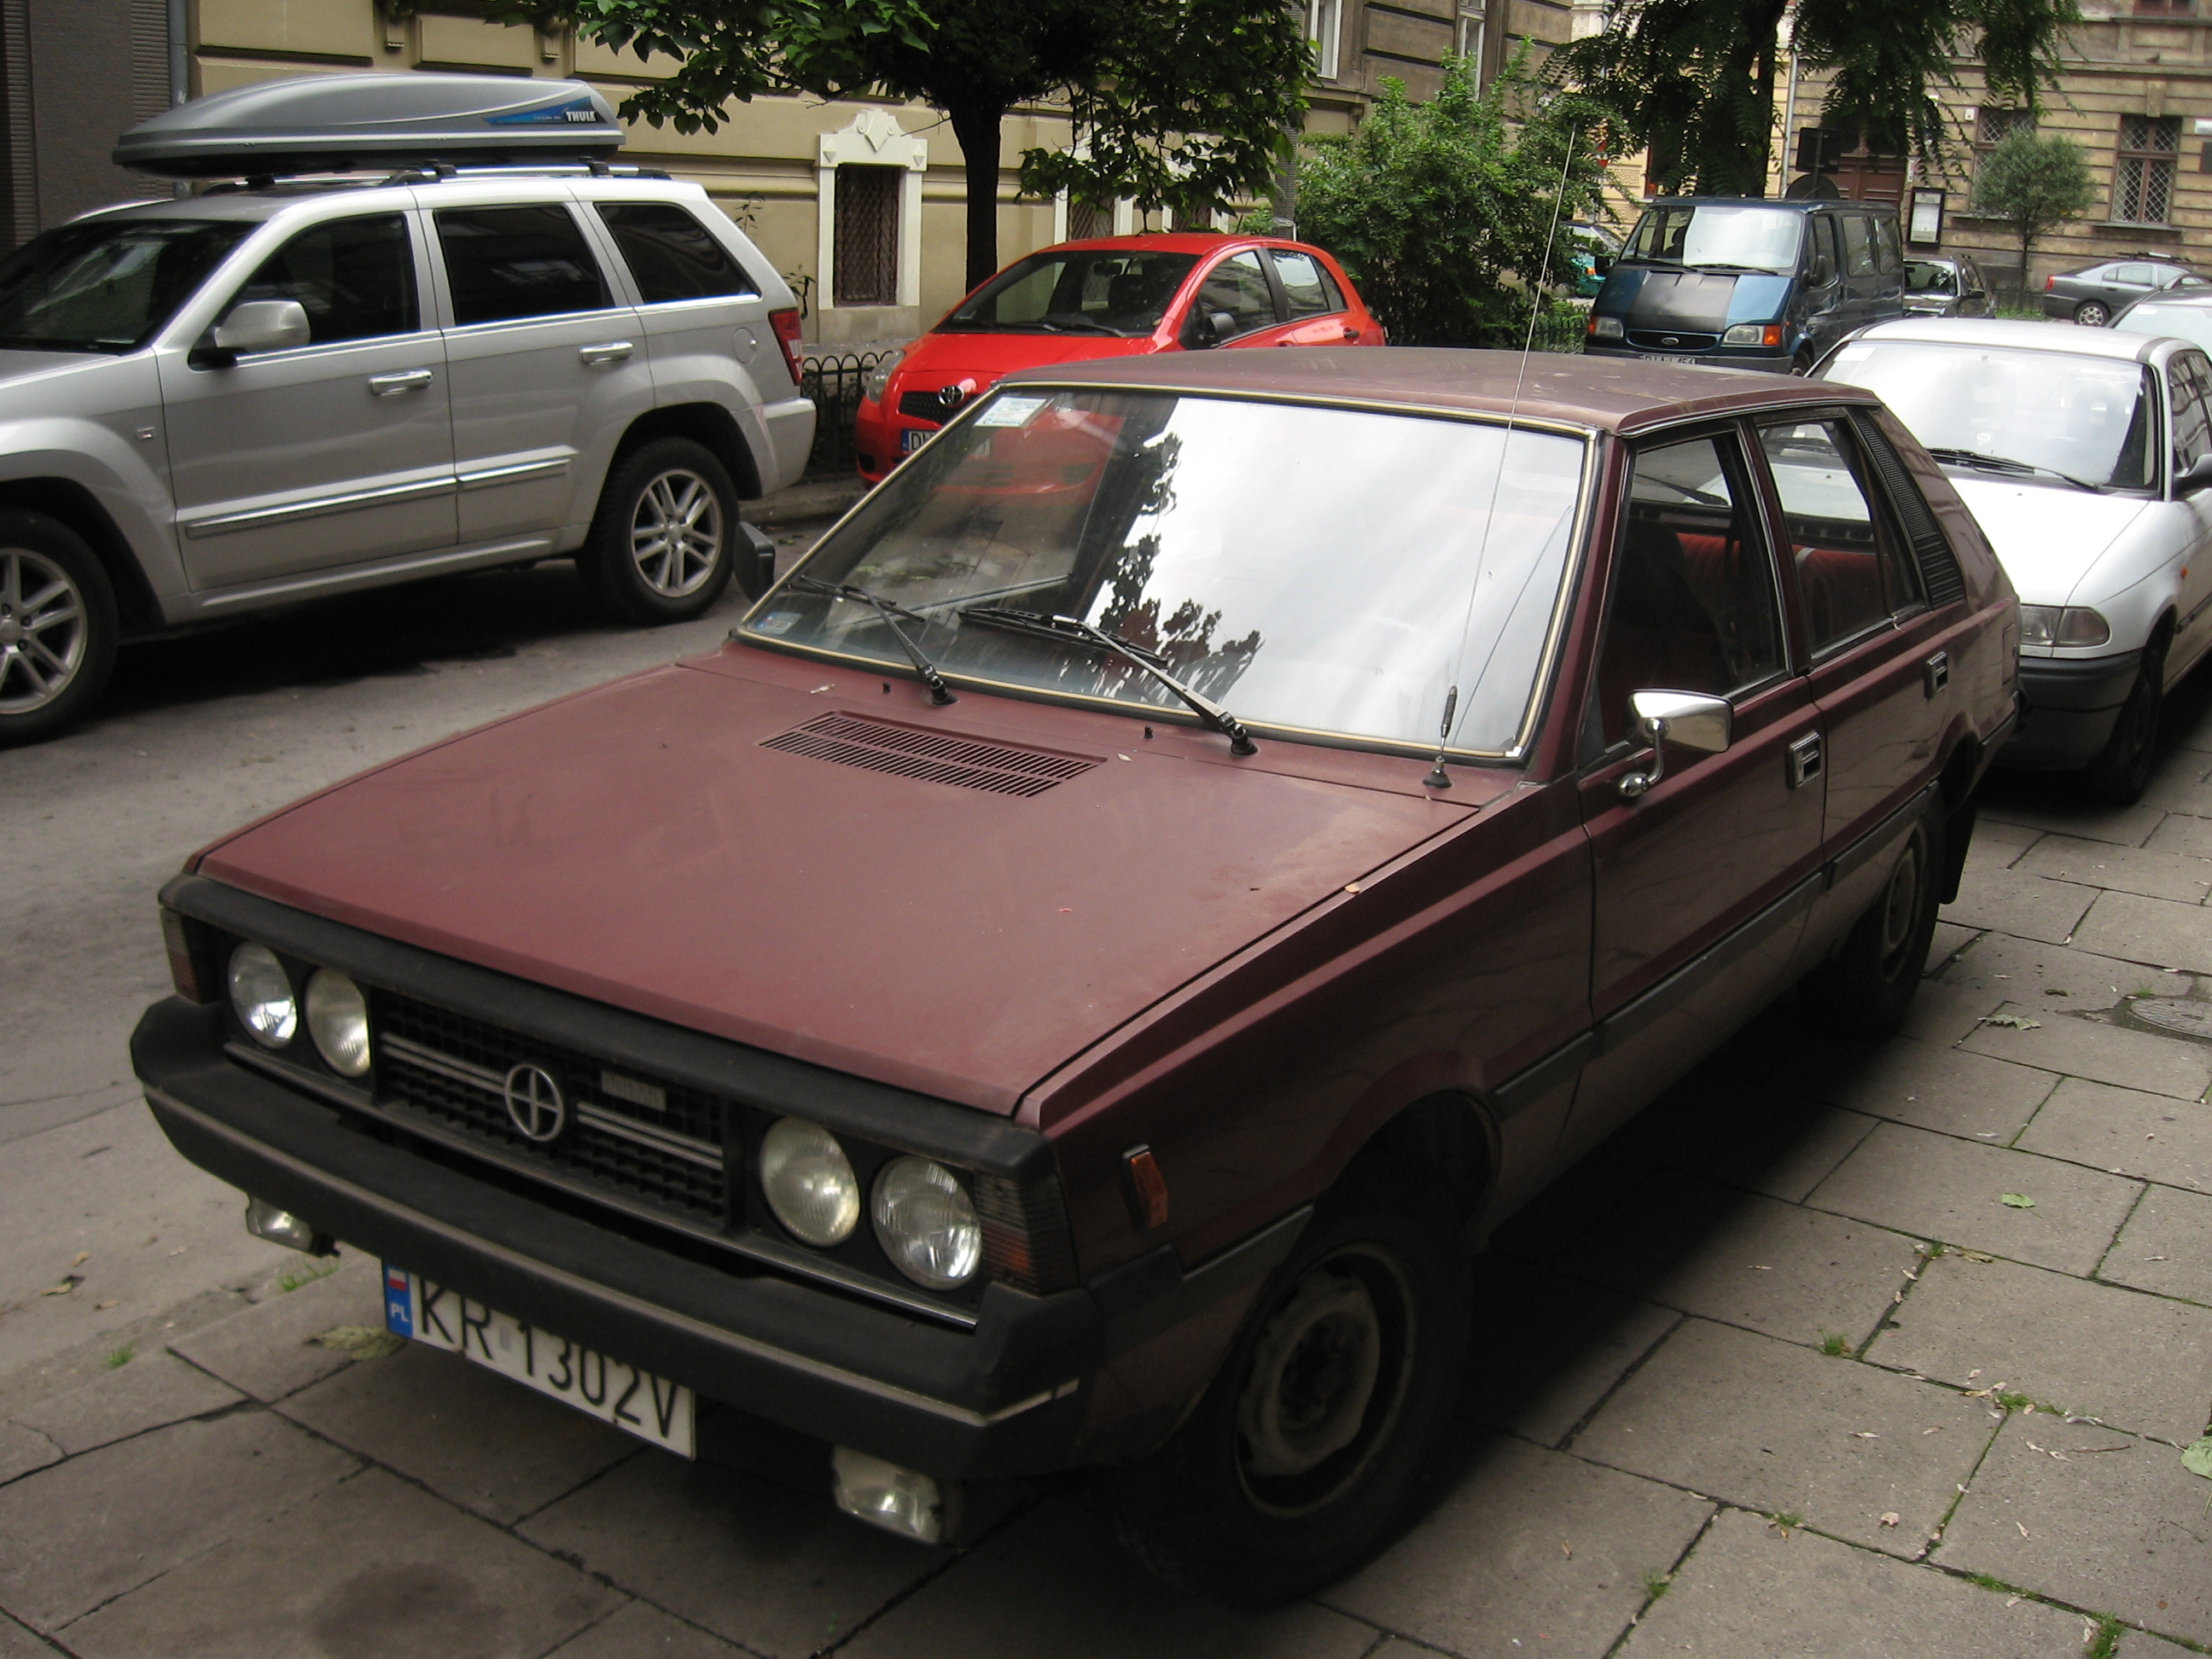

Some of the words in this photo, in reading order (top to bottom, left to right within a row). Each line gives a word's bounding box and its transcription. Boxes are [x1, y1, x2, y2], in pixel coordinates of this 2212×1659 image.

[565, 111, 596, 122] THULE
[390, 1302, 410, 1323] PL
[419, 1276, 493, 1360] KR
[518, 1323, 678, 1438] 1302V
